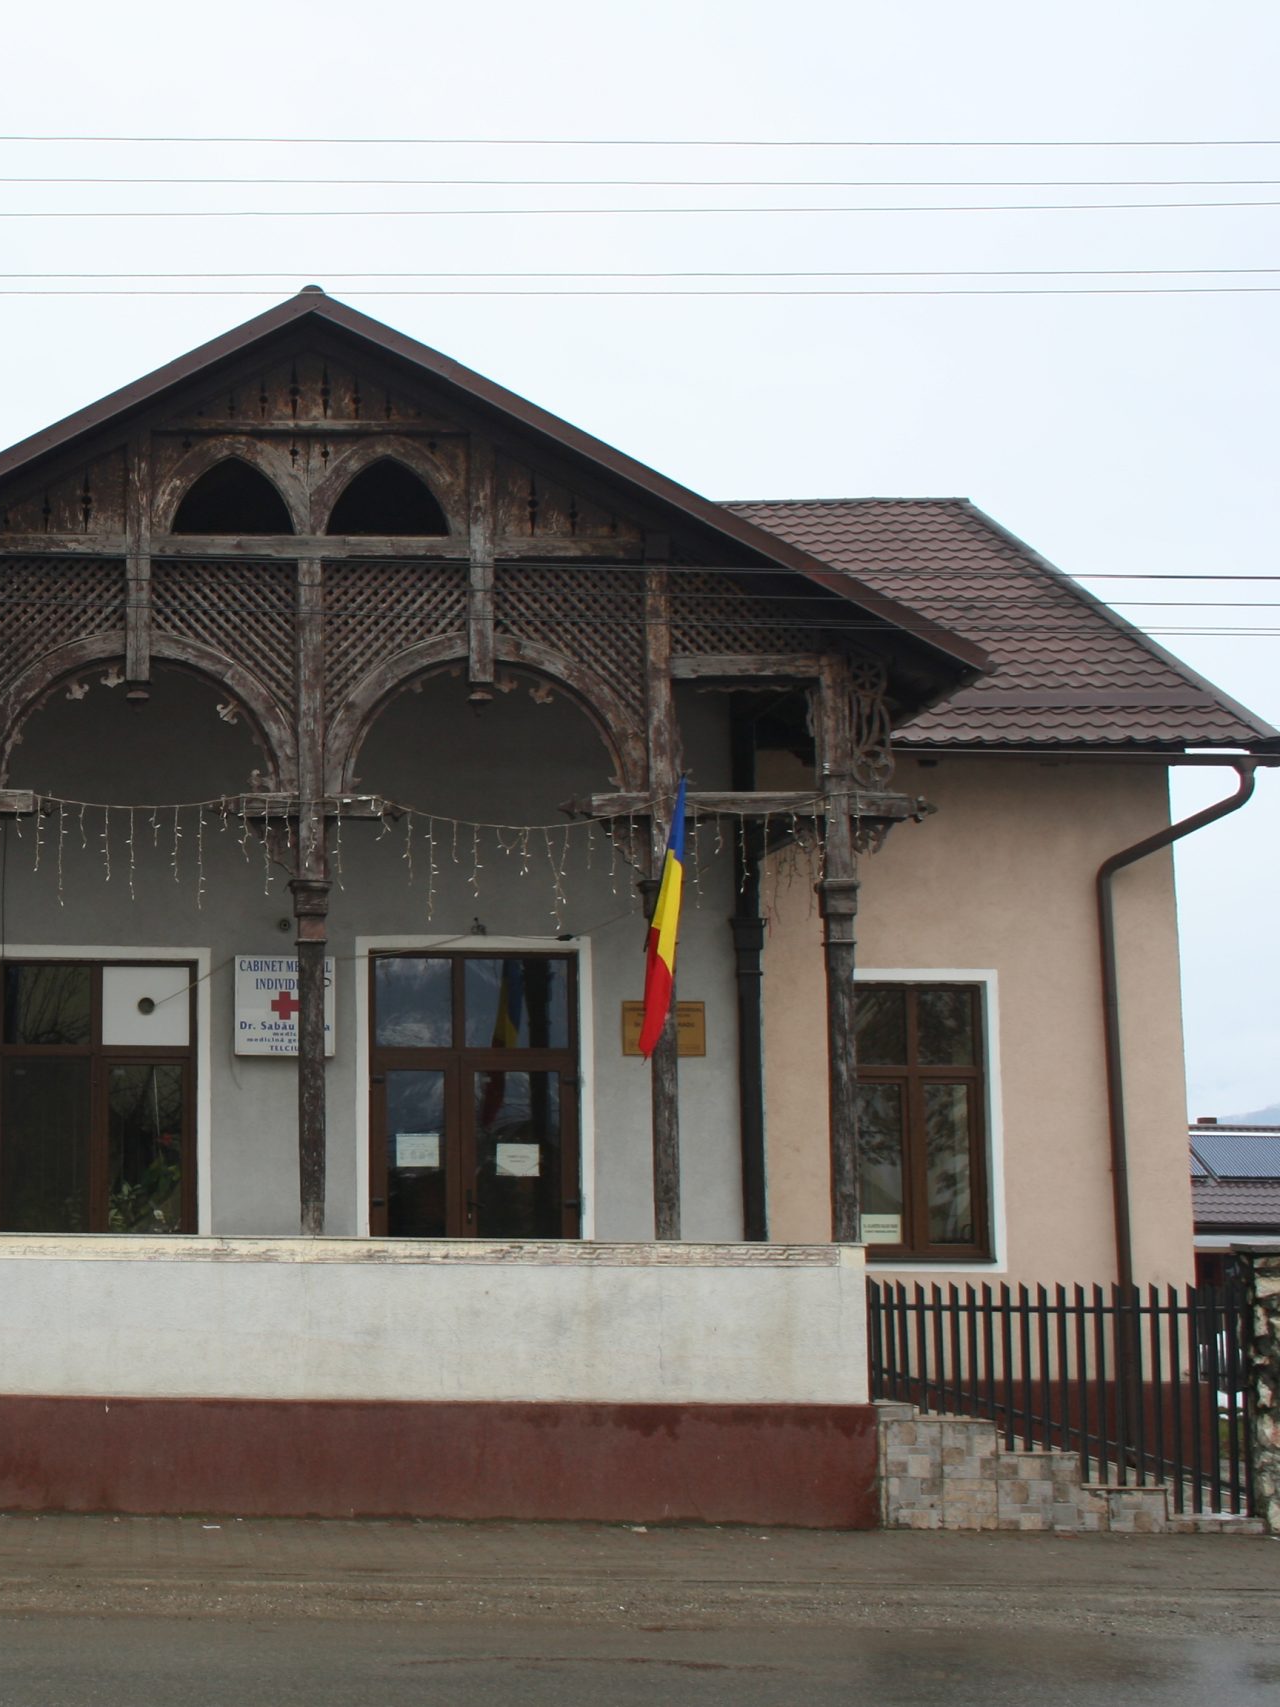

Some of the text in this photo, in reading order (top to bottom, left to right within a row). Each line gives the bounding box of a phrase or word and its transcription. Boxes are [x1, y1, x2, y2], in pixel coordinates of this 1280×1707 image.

[239, 960, 284, 973] CABINET
[255, 978, 299, 990] INDIVID
[239, 1021, 256, 1031] Dr.
